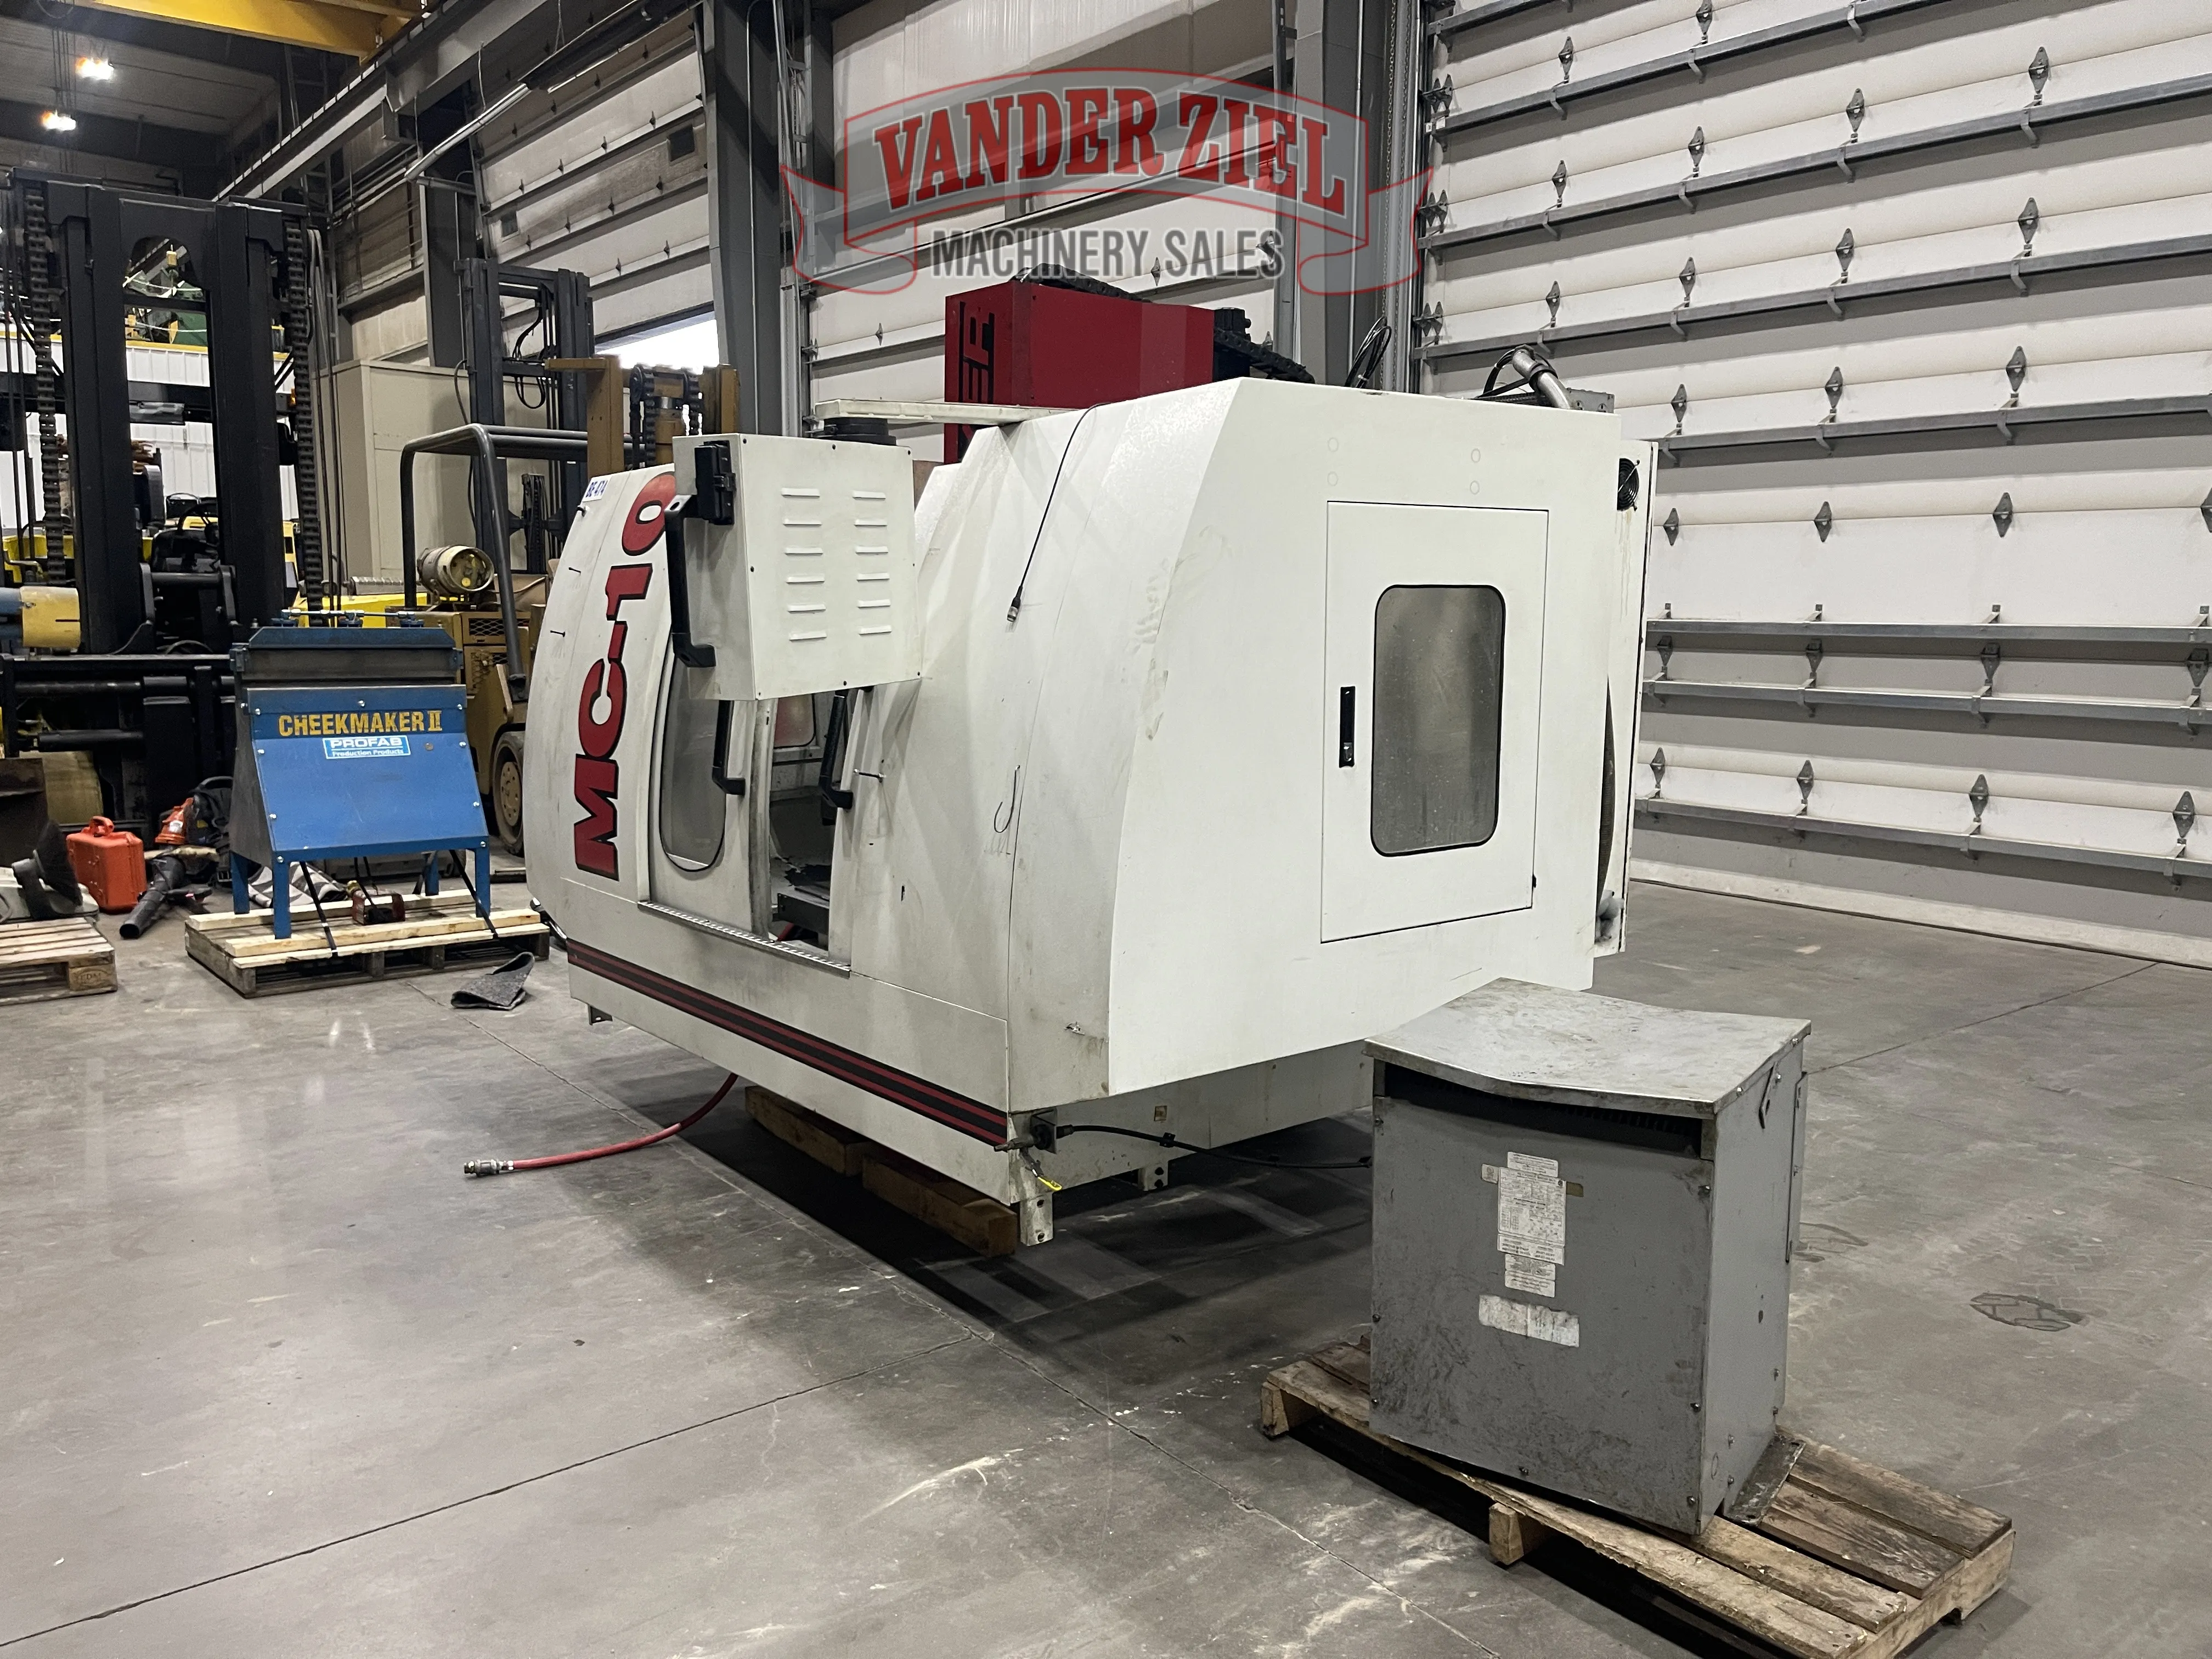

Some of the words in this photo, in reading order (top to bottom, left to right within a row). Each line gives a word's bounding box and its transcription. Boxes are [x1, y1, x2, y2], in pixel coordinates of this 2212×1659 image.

[573, 471, 675, 881] MC-10
[278, 711, 425, 737] CHEEKMAKER
[427, 710, 443, 732] II
[330, 737, 403, 748] PROFAB
